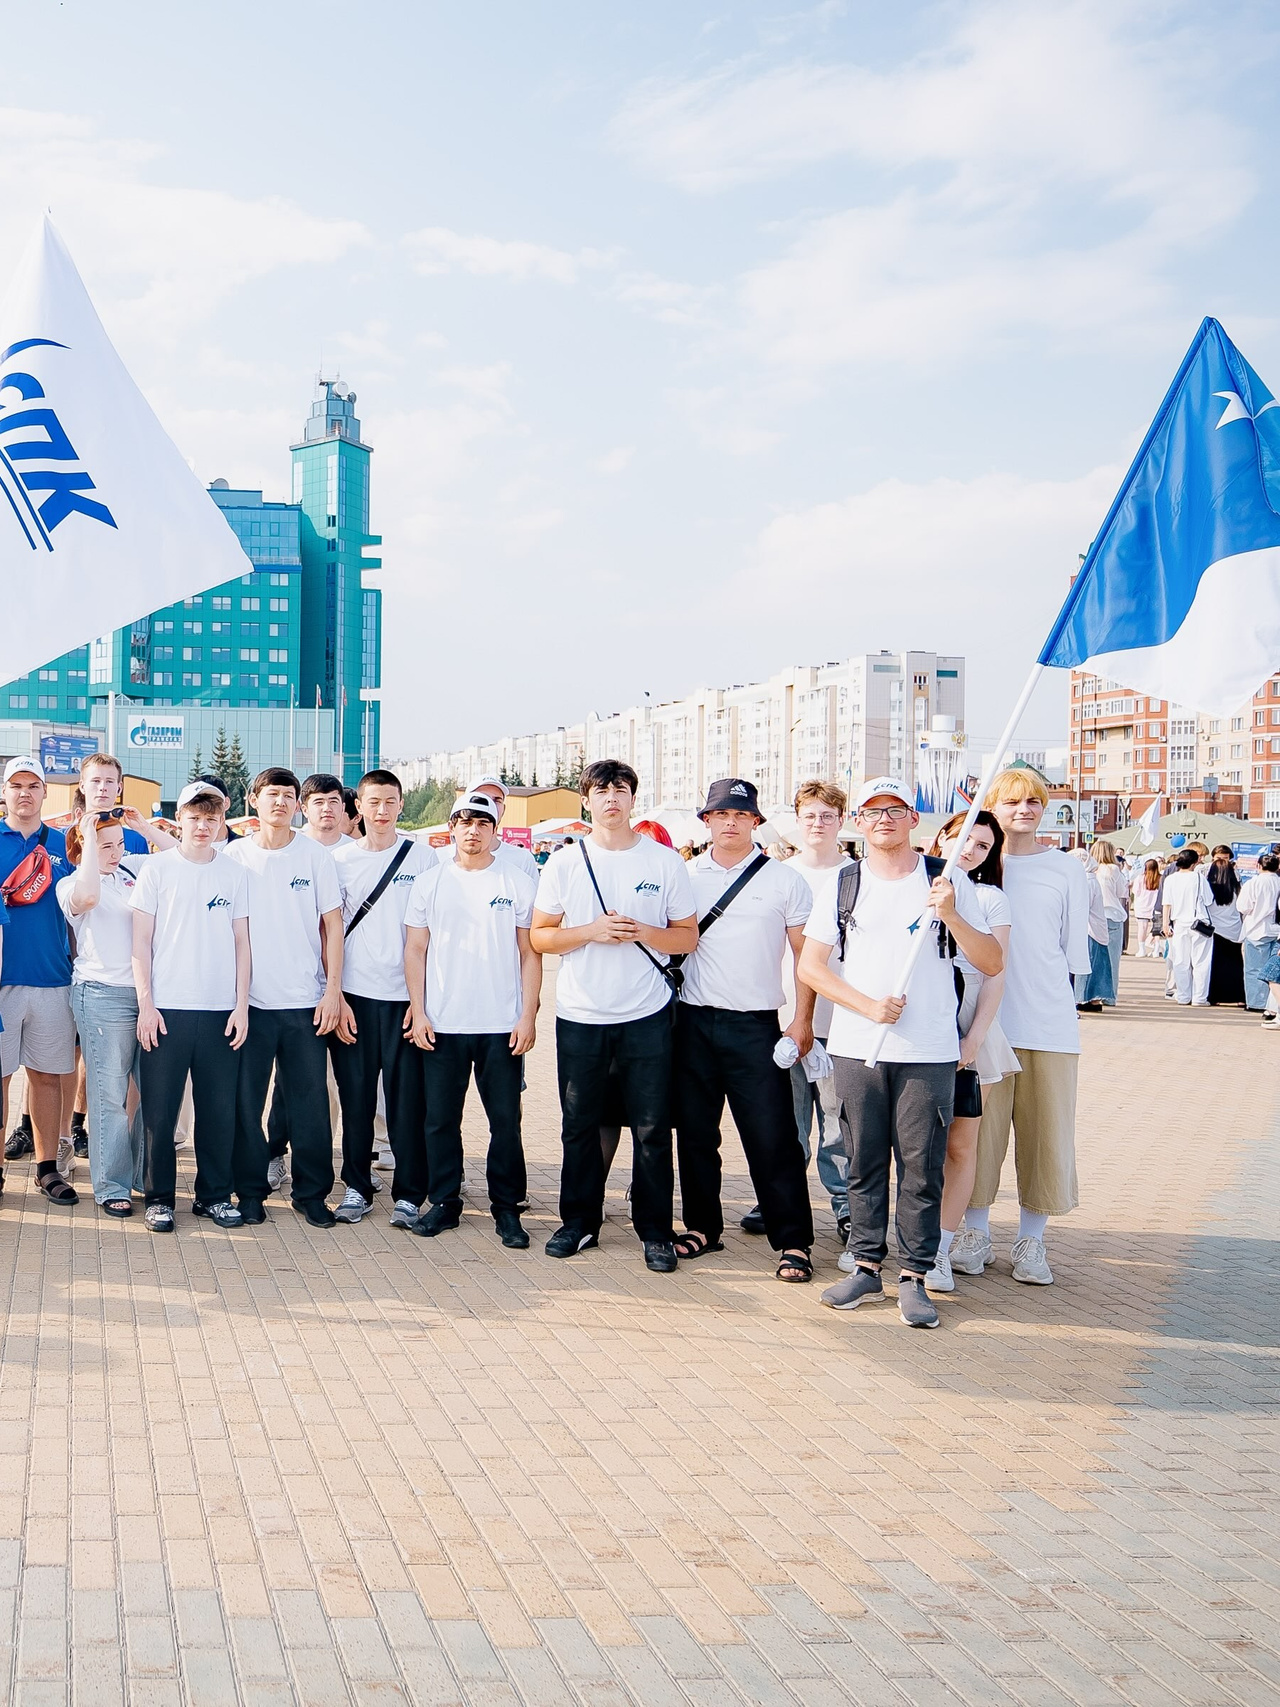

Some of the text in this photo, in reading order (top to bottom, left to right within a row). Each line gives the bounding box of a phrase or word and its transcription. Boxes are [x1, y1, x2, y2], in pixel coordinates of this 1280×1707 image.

[147, 726, 182, 736] ГАЗПРОМ
[23, 872, 47, 901] SPORTS
[294, 878, 311, 886] СПК
[643, 882, 661, 891] СПК
[497, 897, 513, 906] СПК
